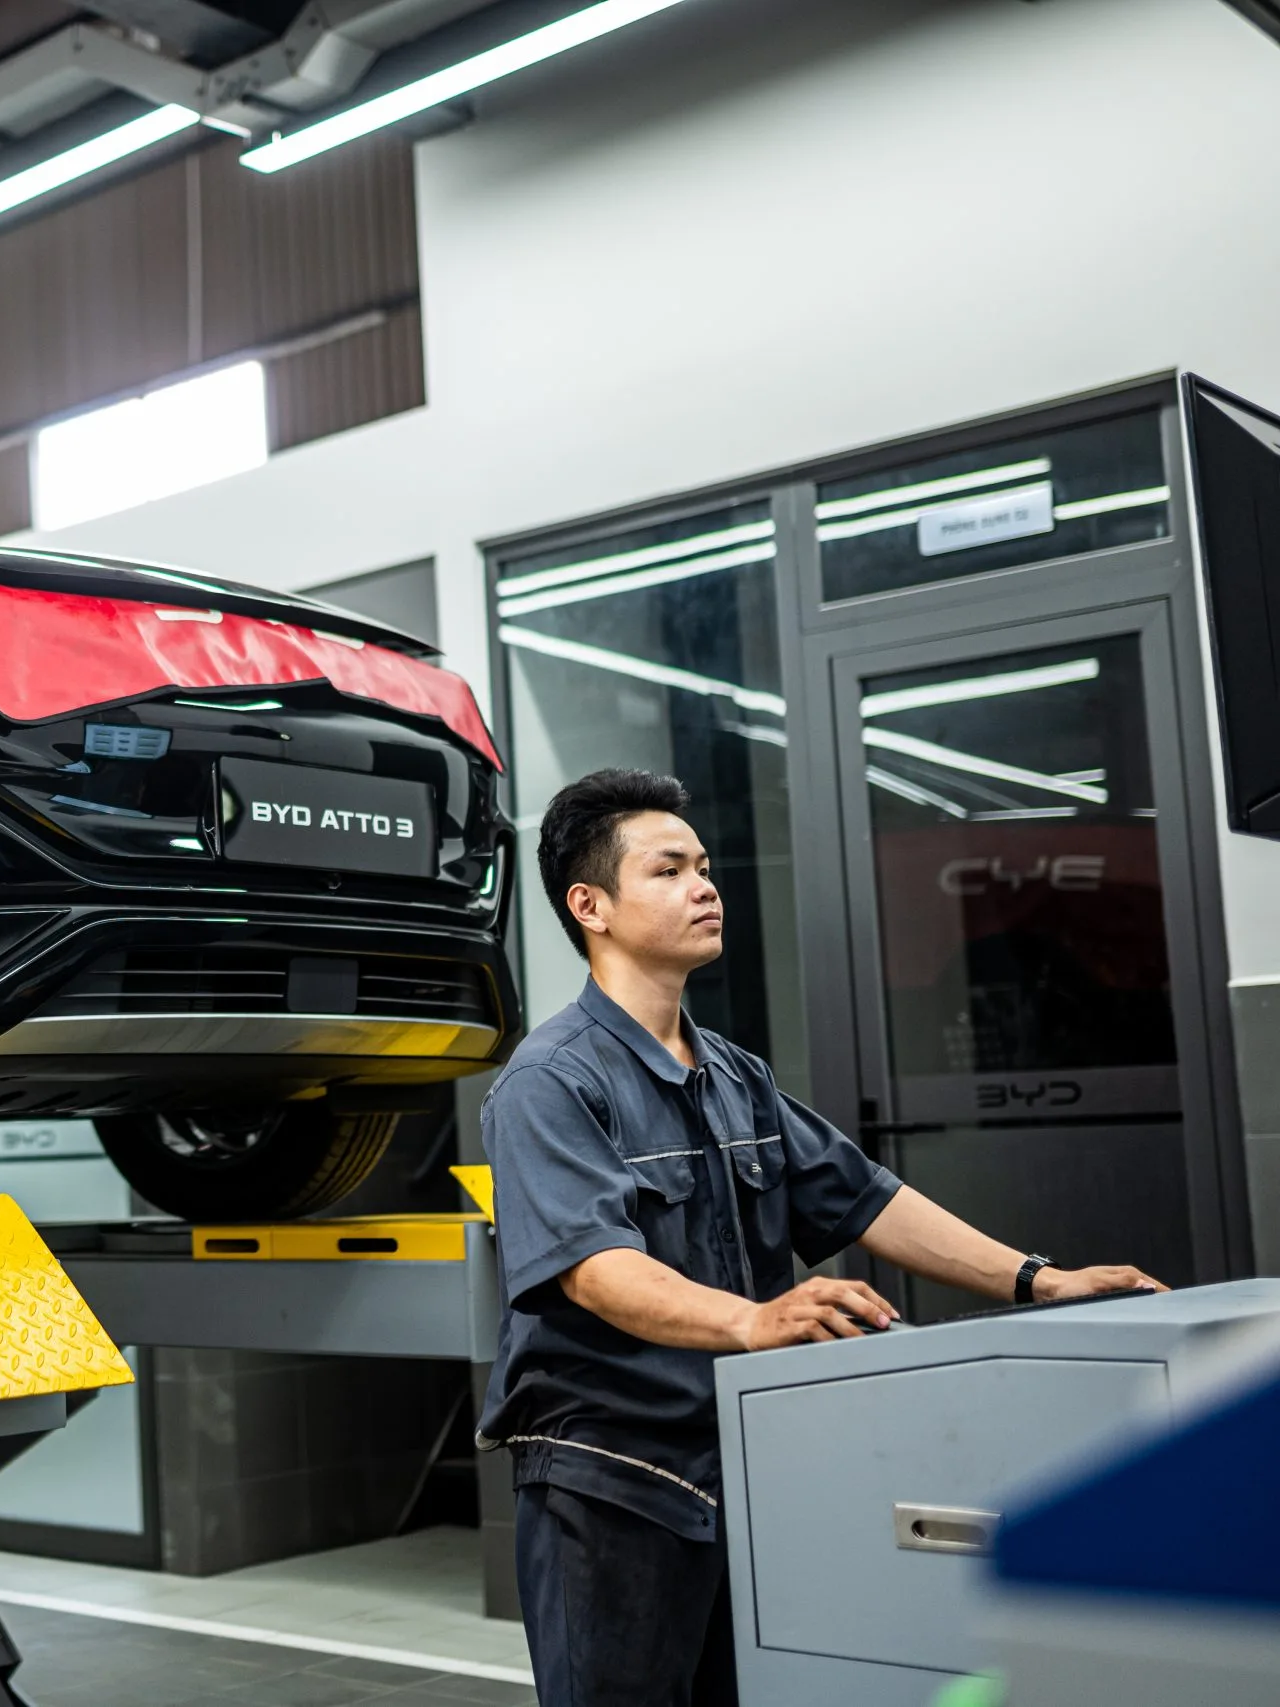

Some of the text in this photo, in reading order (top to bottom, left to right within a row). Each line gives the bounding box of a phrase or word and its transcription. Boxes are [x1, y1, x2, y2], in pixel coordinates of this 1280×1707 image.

[252, 801, 414, 839] BYD ATTO 3
[977, 1081, 1082, 1109] BYD
